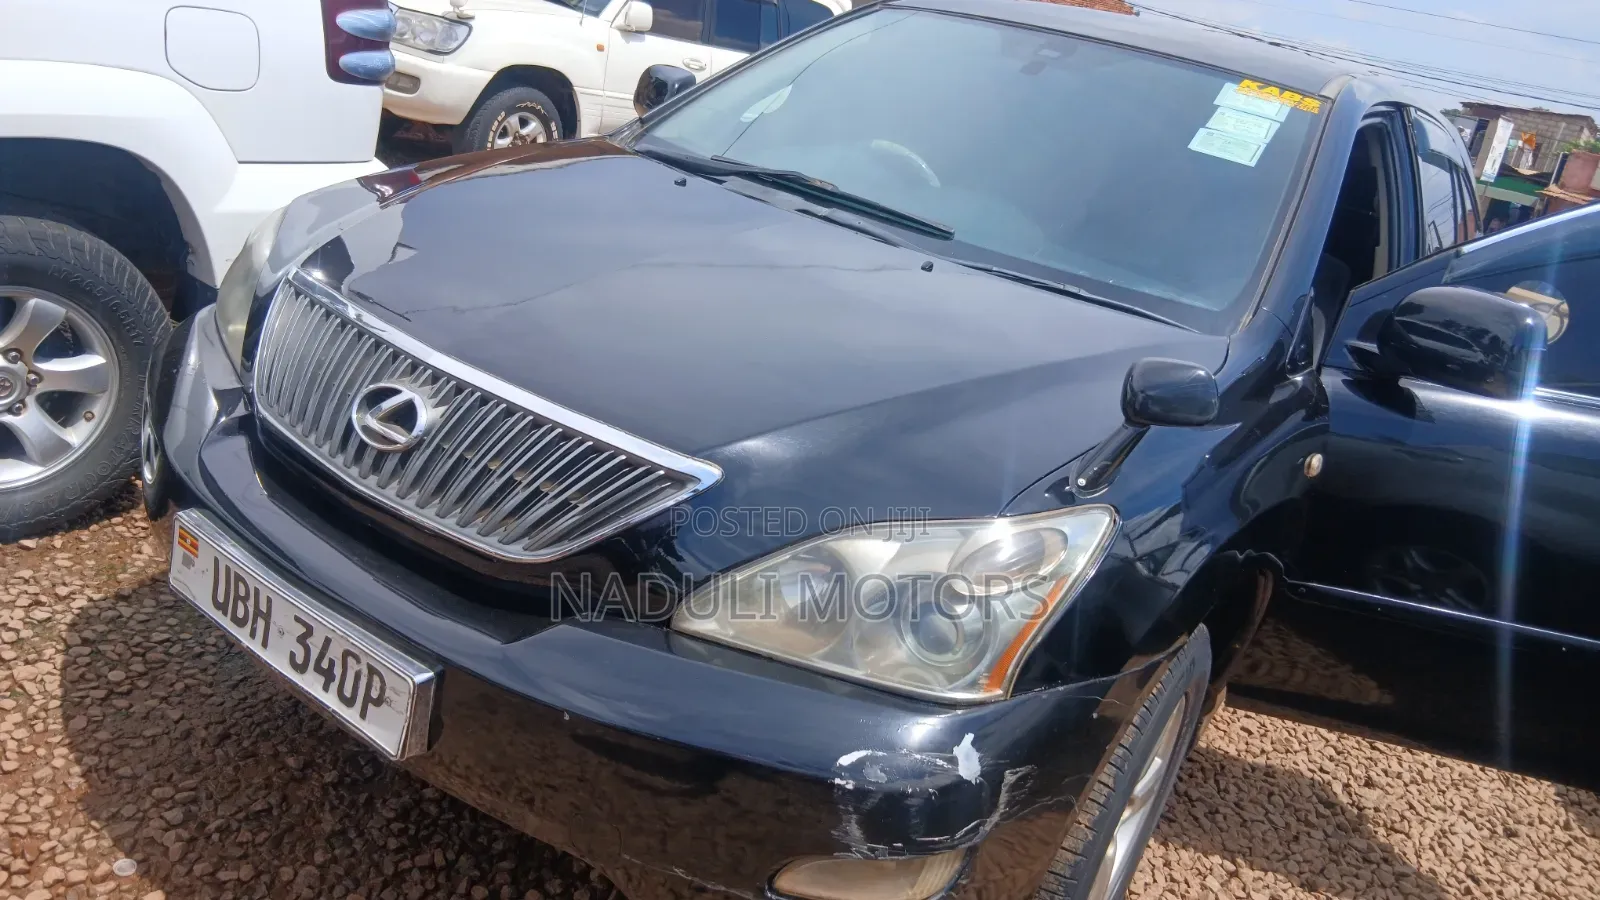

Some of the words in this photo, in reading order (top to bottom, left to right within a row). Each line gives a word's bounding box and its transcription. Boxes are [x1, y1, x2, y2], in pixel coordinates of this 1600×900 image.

[1237, 78, 1322, 109] KABS
[211, 555, 273, 651] UBH
[288, 613, 387, 722] 340P
